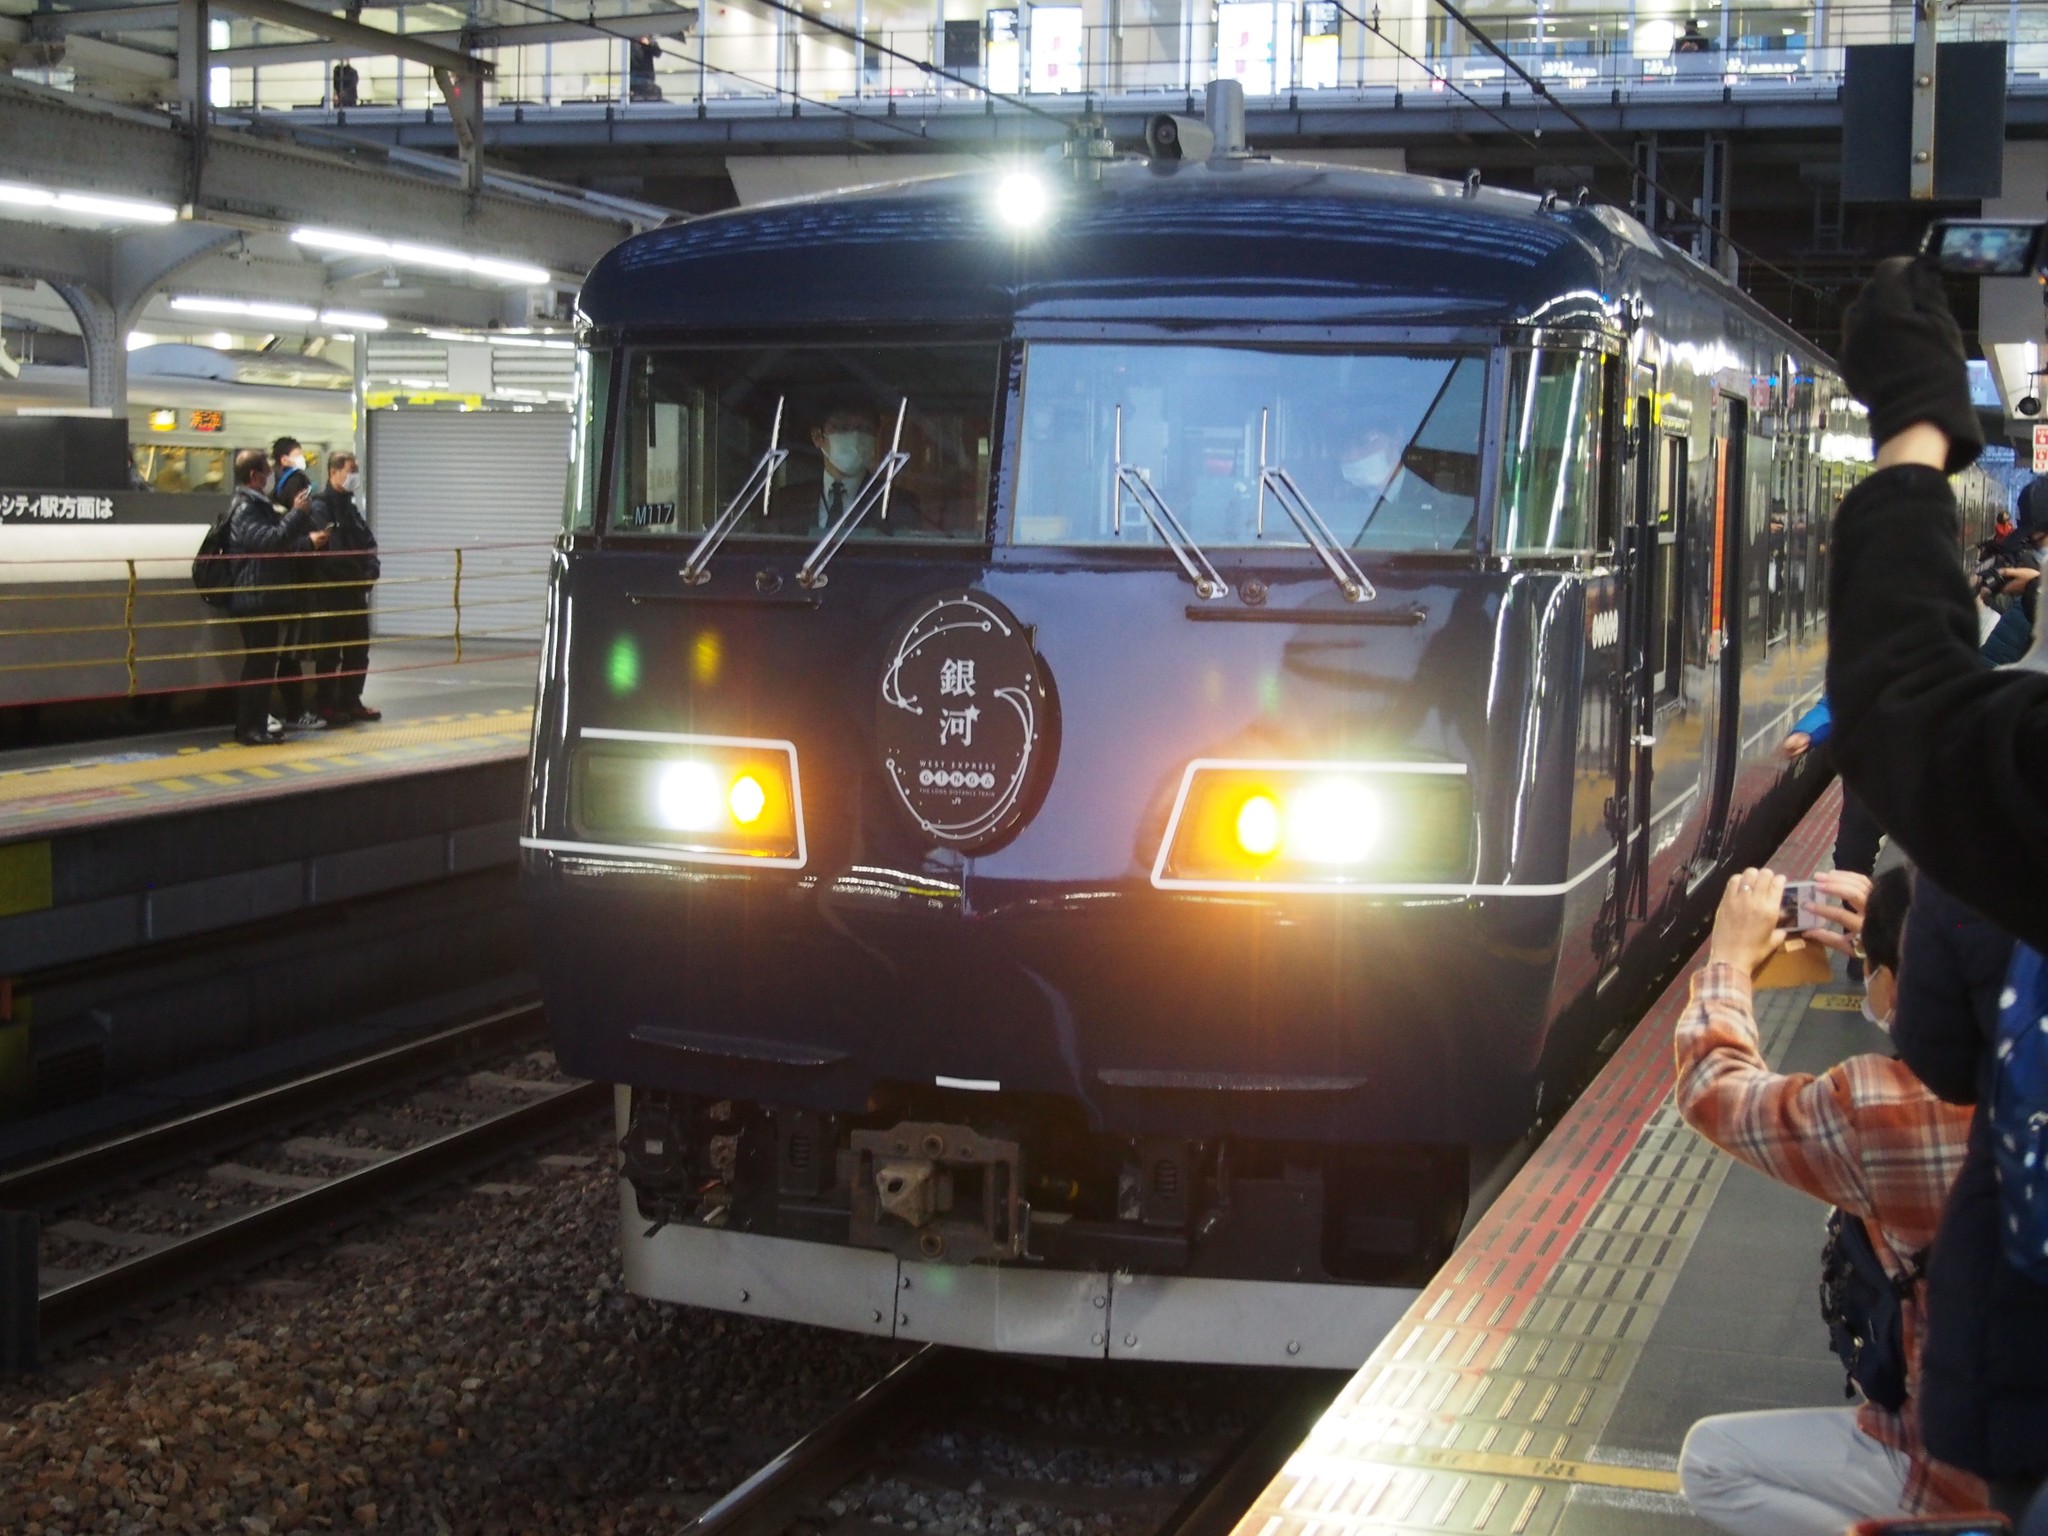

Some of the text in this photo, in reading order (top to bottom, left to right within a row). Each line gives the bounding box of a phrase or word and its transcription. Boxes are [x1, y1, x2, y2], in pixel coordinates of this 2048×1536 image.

[0, 495, 113, 519] シティ駅方面は
[635, 504, 673, 525] M117
[939, 658, 980, 747] 銀河
[919, 759, 996, 771] WEST EXPRESS
[921, 771, 993, 786] GINGA
